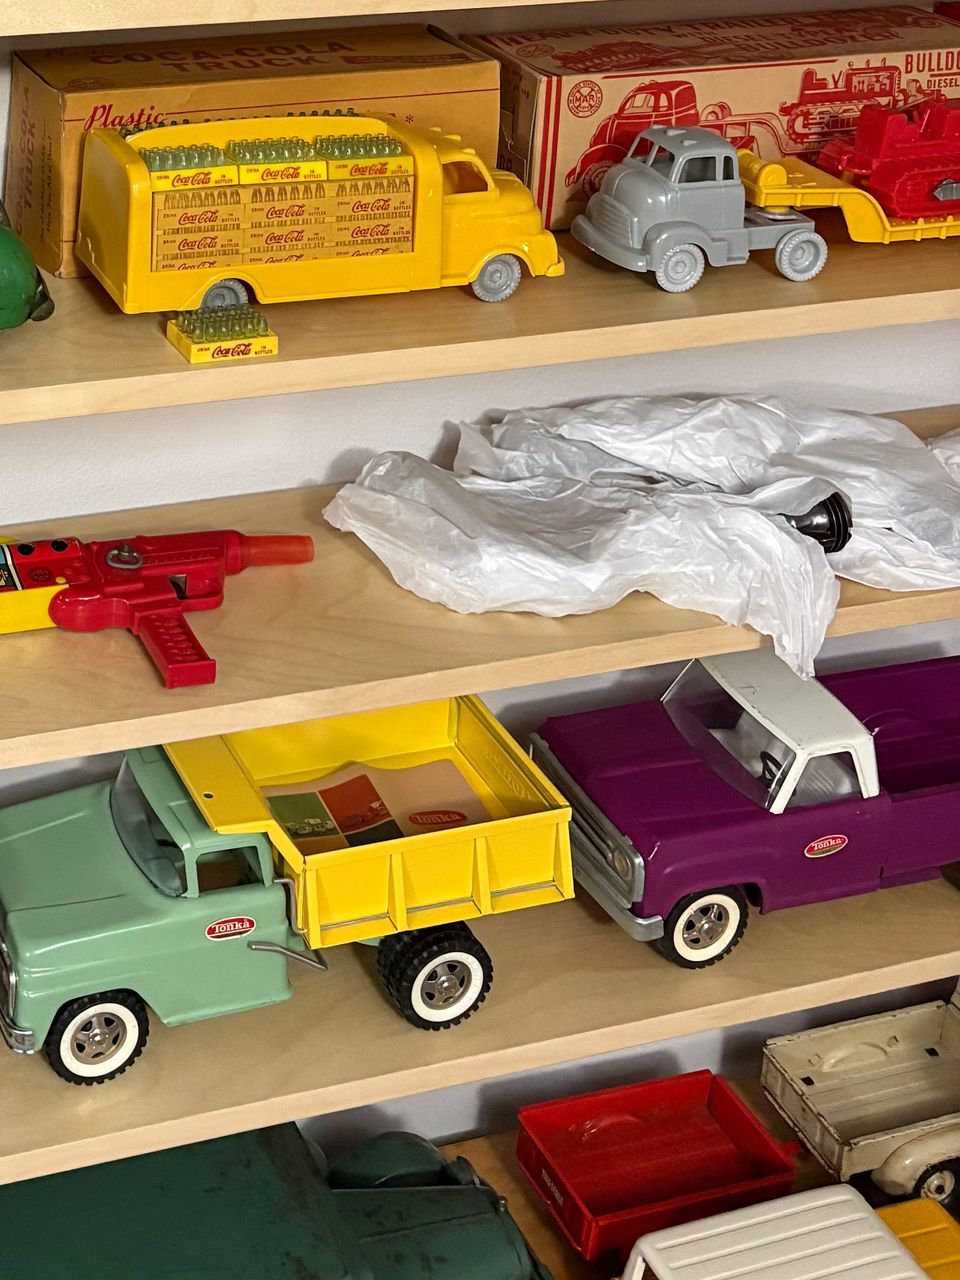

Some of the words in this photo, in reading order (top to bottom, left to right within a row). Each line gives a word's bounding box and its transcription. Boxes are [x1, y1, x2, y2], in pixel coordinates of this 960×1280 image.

[91, 41, 357, 65] COCA-COLA
[161, 55, 329, 74] TRUCK
[927, 78, 960, 89] DIESEL
[84, 103, 167, 131] Plastic
[812, 837, 843, 851] Tonka
[212, 919, 250, 934] Tonka
